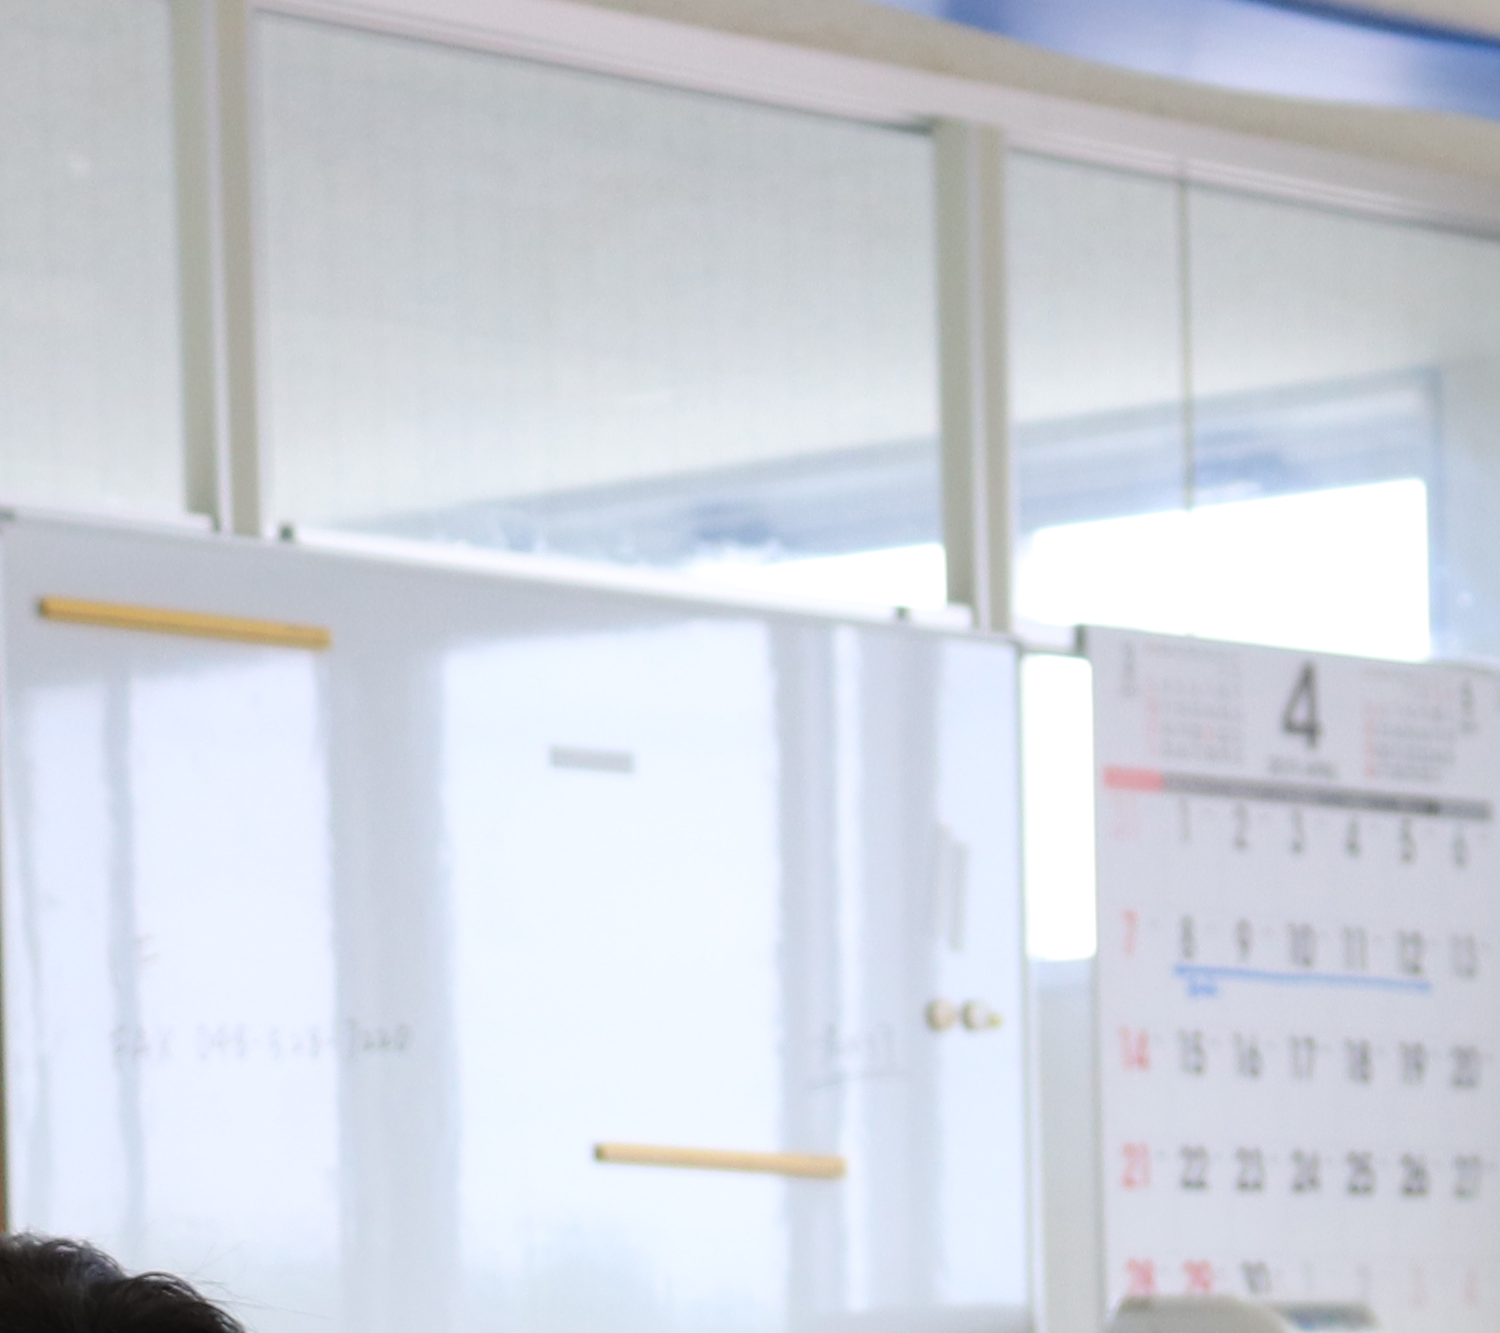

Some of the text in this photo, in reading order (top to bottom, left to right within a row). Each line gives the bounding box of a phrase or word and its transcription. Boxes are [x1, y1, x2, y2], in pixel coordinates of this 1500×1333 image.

[1280, 659, 1323, 750] 4
[1288, 922, 1316, 968] 10
[1342, 925, 1368, 970] 11
[1397, 930, 1423, 976] 12
[1118, 1025, 1481, 1089] 14 15 16 17 18 19 20
[1121, 1142, 1482, 1199] 21 22 23 24 25 26 27
